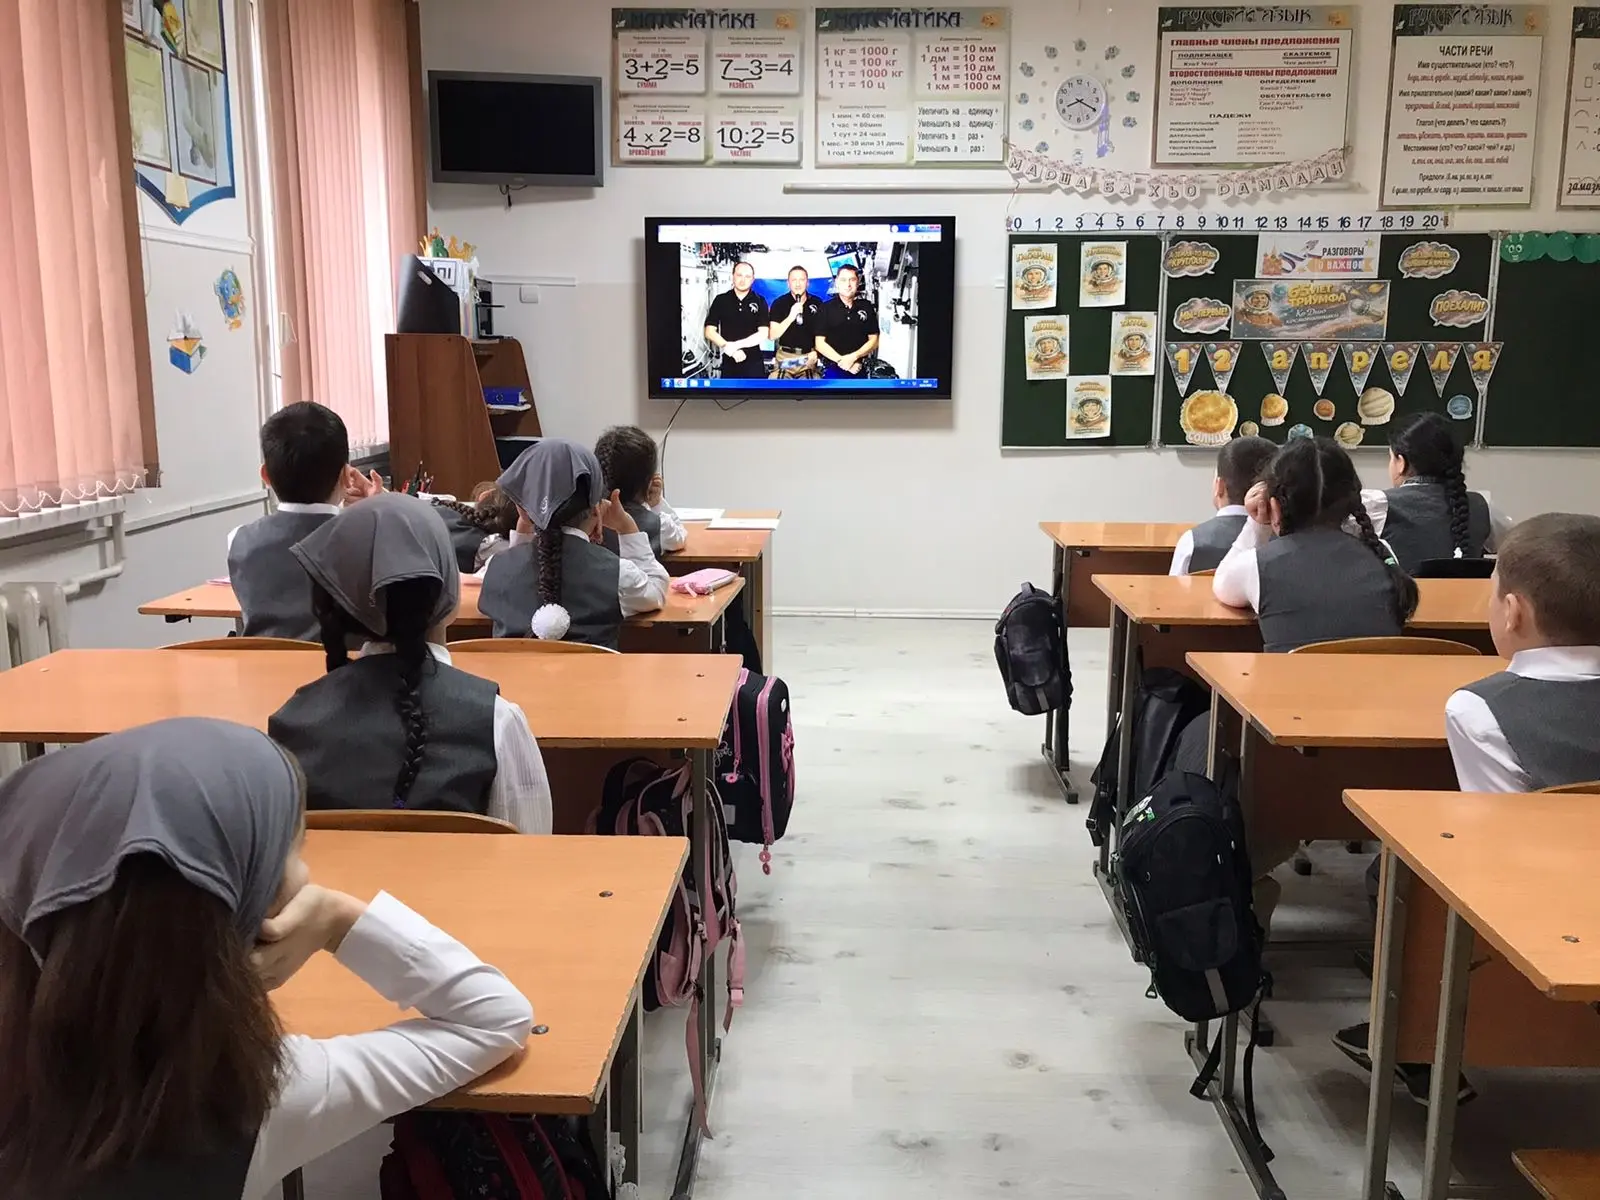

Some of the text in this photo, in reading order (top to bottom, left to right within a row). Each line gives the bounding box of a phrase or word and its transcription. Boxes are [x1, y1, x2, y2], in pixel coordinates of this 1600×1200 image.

[861, 46, 888, 56] 1000
[963, 44, 976, 53] 10
[1439, 45, 1493, 56] ЧАСТИ РЕЧИ
[861, 57, 881, 67] 100
[963, 54, 976, 62] 10
[625, 58, 699, 75] 3+2=5
[964, 63, 976, 71] 10
[861, 68, 888, 78] 1000
[861, 80, 873, 89] 10
[964, 82, 989, 90] 1000
[1013, 215, 1439, 229] 0 1 2 3 4 5 6 7 8 9 10 11 12 13 14 15 16 17 18 19 20
[1322, 247, 1364, 256] РАЗГОВОРЫ
